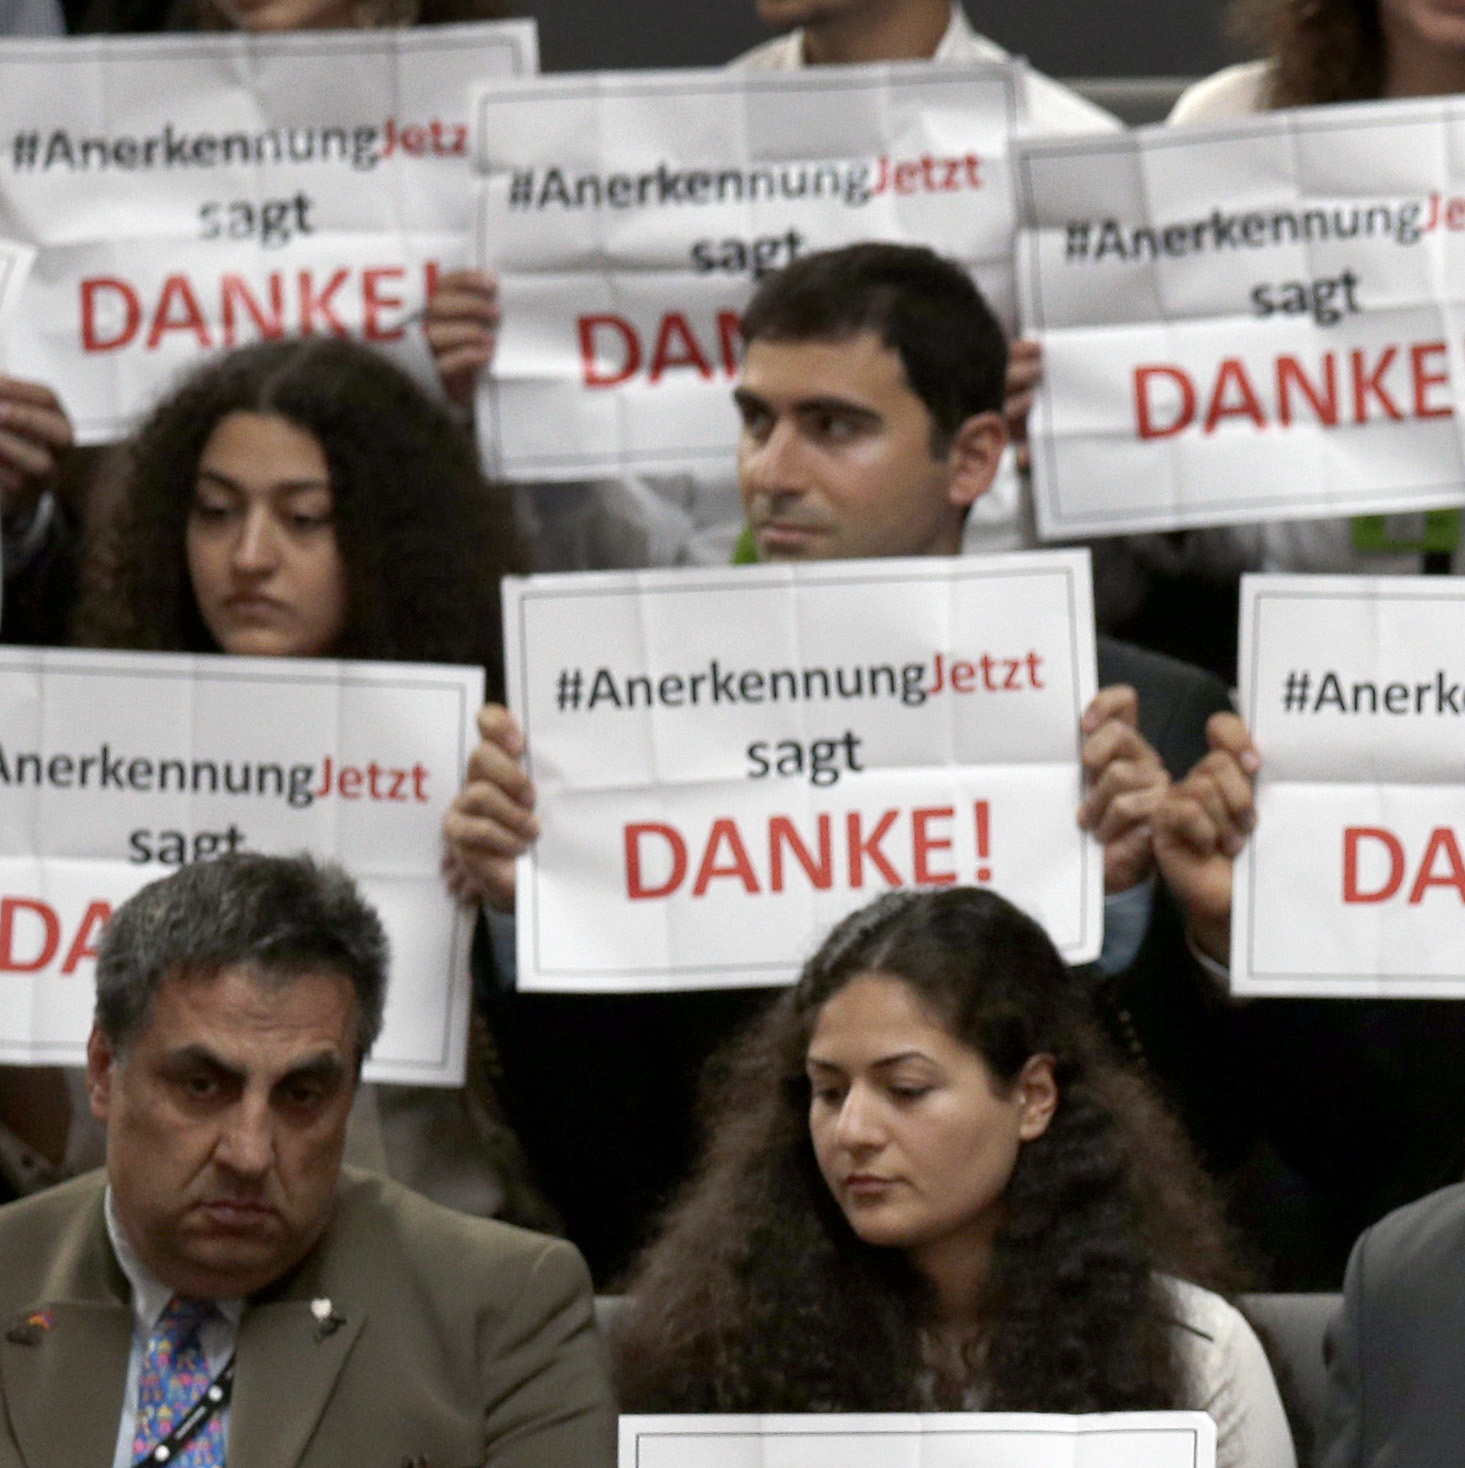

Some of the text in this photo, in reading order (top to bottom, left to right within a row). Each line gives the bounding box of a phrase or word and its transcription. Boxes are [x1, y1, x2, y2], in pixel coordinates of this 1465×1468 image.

[11, 118, 469, 171] #AnerkennungJetz
[507, 150, 983, 210] #AnerkennungJetzt
[198, 192, 315, 247] sagt
[1250, 269, 1361, 330] sagt
[556, 651, 1044, 712] #AnerkennungJetzt
[0, 743, 429, 809] nerkennungJetzt
[746, 729, 864, 788] sagt
[623, 799, 991, 901] DANKE!
